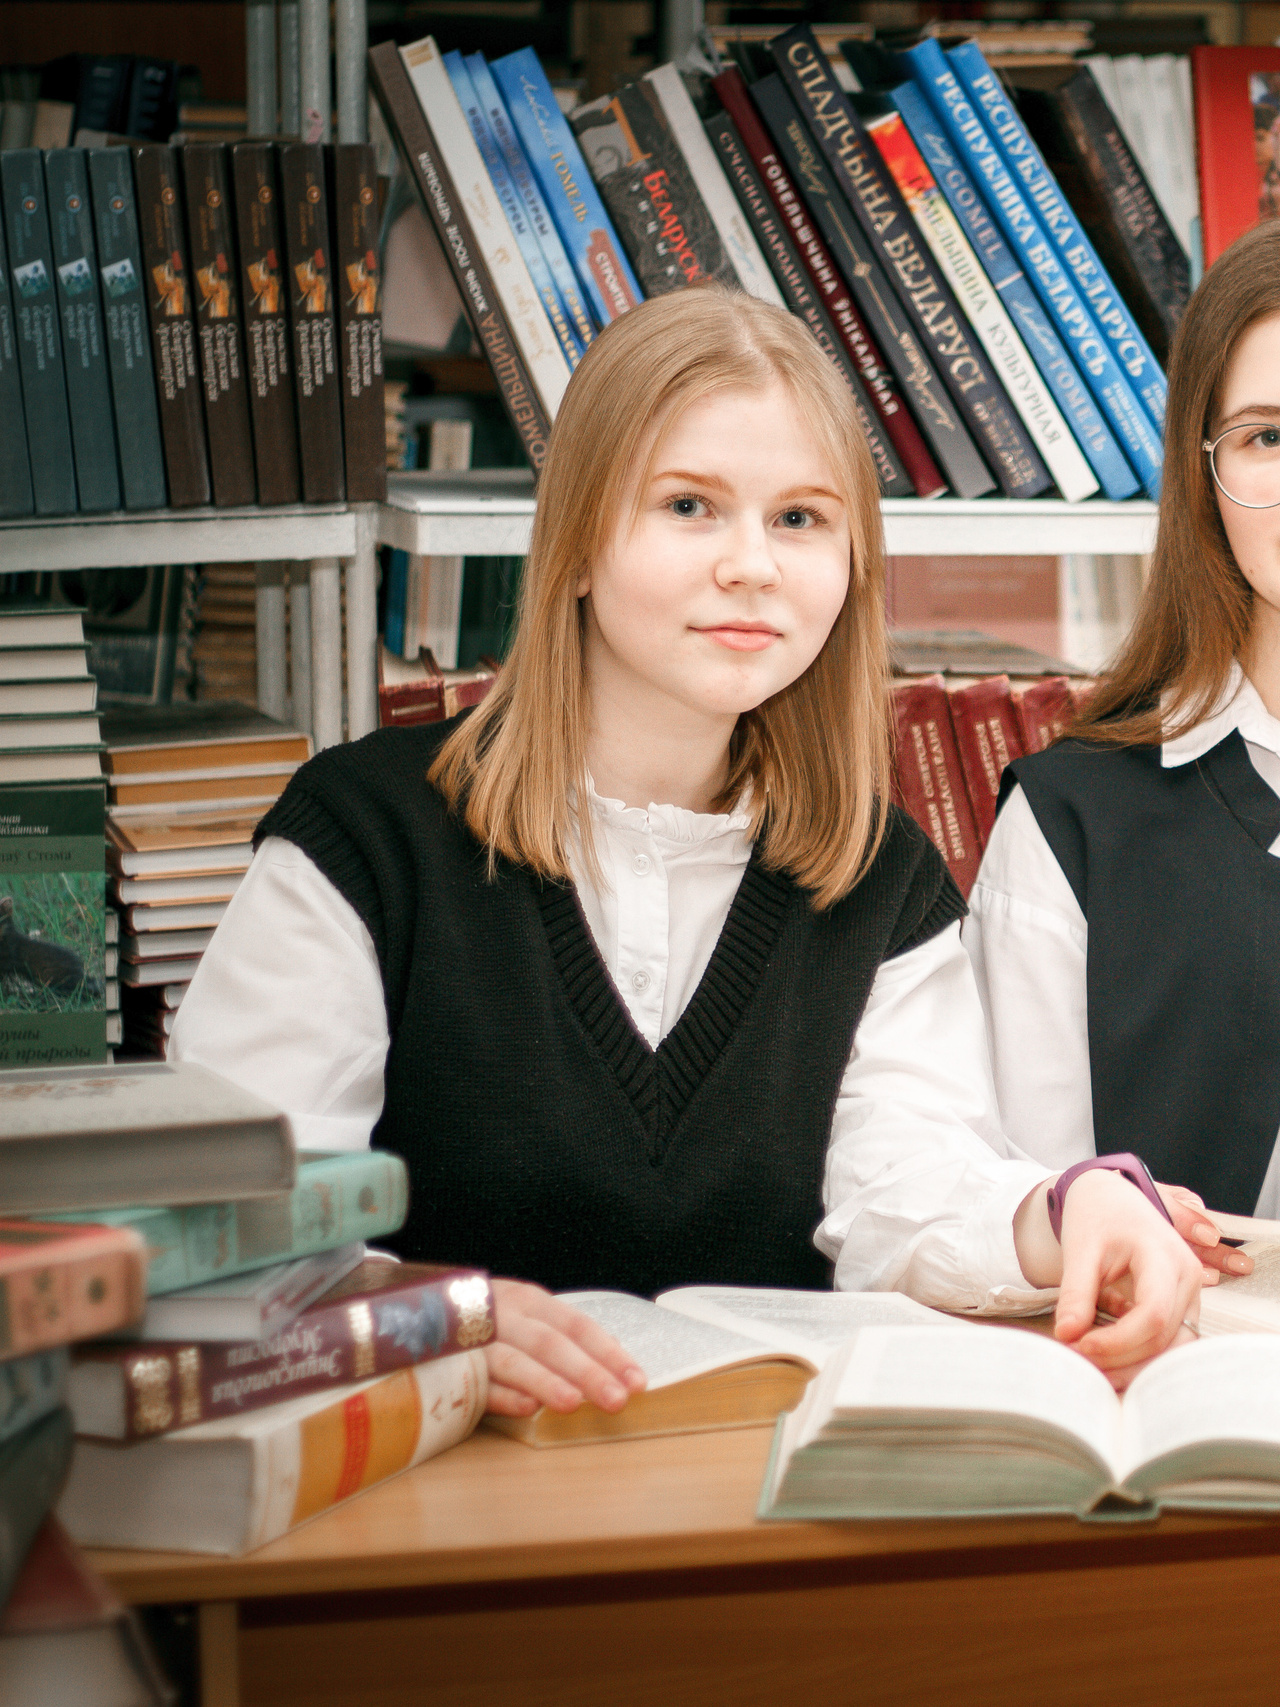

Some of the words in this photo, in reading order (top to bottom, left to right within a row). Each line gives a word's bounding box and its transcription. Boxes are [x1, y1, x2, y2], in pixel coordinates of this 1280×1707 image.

[602, 97, 654, 167] 1
[418, 151, 452, 224] ЧЕРНОБЫЛЯ
[495, 169, 527, 234] РЕСУРСЫ
[516, 172, 549, 236] РЕСУРСЫ
[551, 151, 589, 224] ГОМЕЛЬ
[719, 131, 769, 219] СУЧАСНАЕ
[761, 219, 812, 307] НАРОДНАЕ
[787, 41, 899, 236] СПАДЧЫНА
[882, 231, 987, 394] БЕЛАРУСІ
[935, 70, 1037, 244] РЕСПУБЛИКА
[1027, 241, 1108, 377] БЕЛАРУСЬ
[945, 168, 1003, 260] GOMEL
[972, 74, 1075, 246] РЕСПУБЛИКА
[1064, 244, 1148, 378] БЕЛАРУСЬ
[446, 224, 471, 268] ПОСЛЕ
[465, 268, 489, 313] ЖИЗНЬ
[908, 175, 989, 313] ГОМЕЛЬЩИНА
[987, 322, 1062, 445] КУЛЬТУРНАЯ
[985, 396, 1037, 483] HERITAGE
[1049, 357, 1107, 453] ГОМЕЛЬ
[911, 723, 935, 799] СОВЕТСКАЯ
[926, 719, 966, 861] ЭНЦИКЛОПЕДИЯ
[974, 720, 1000, 797] СОВЕТСКАЯ
